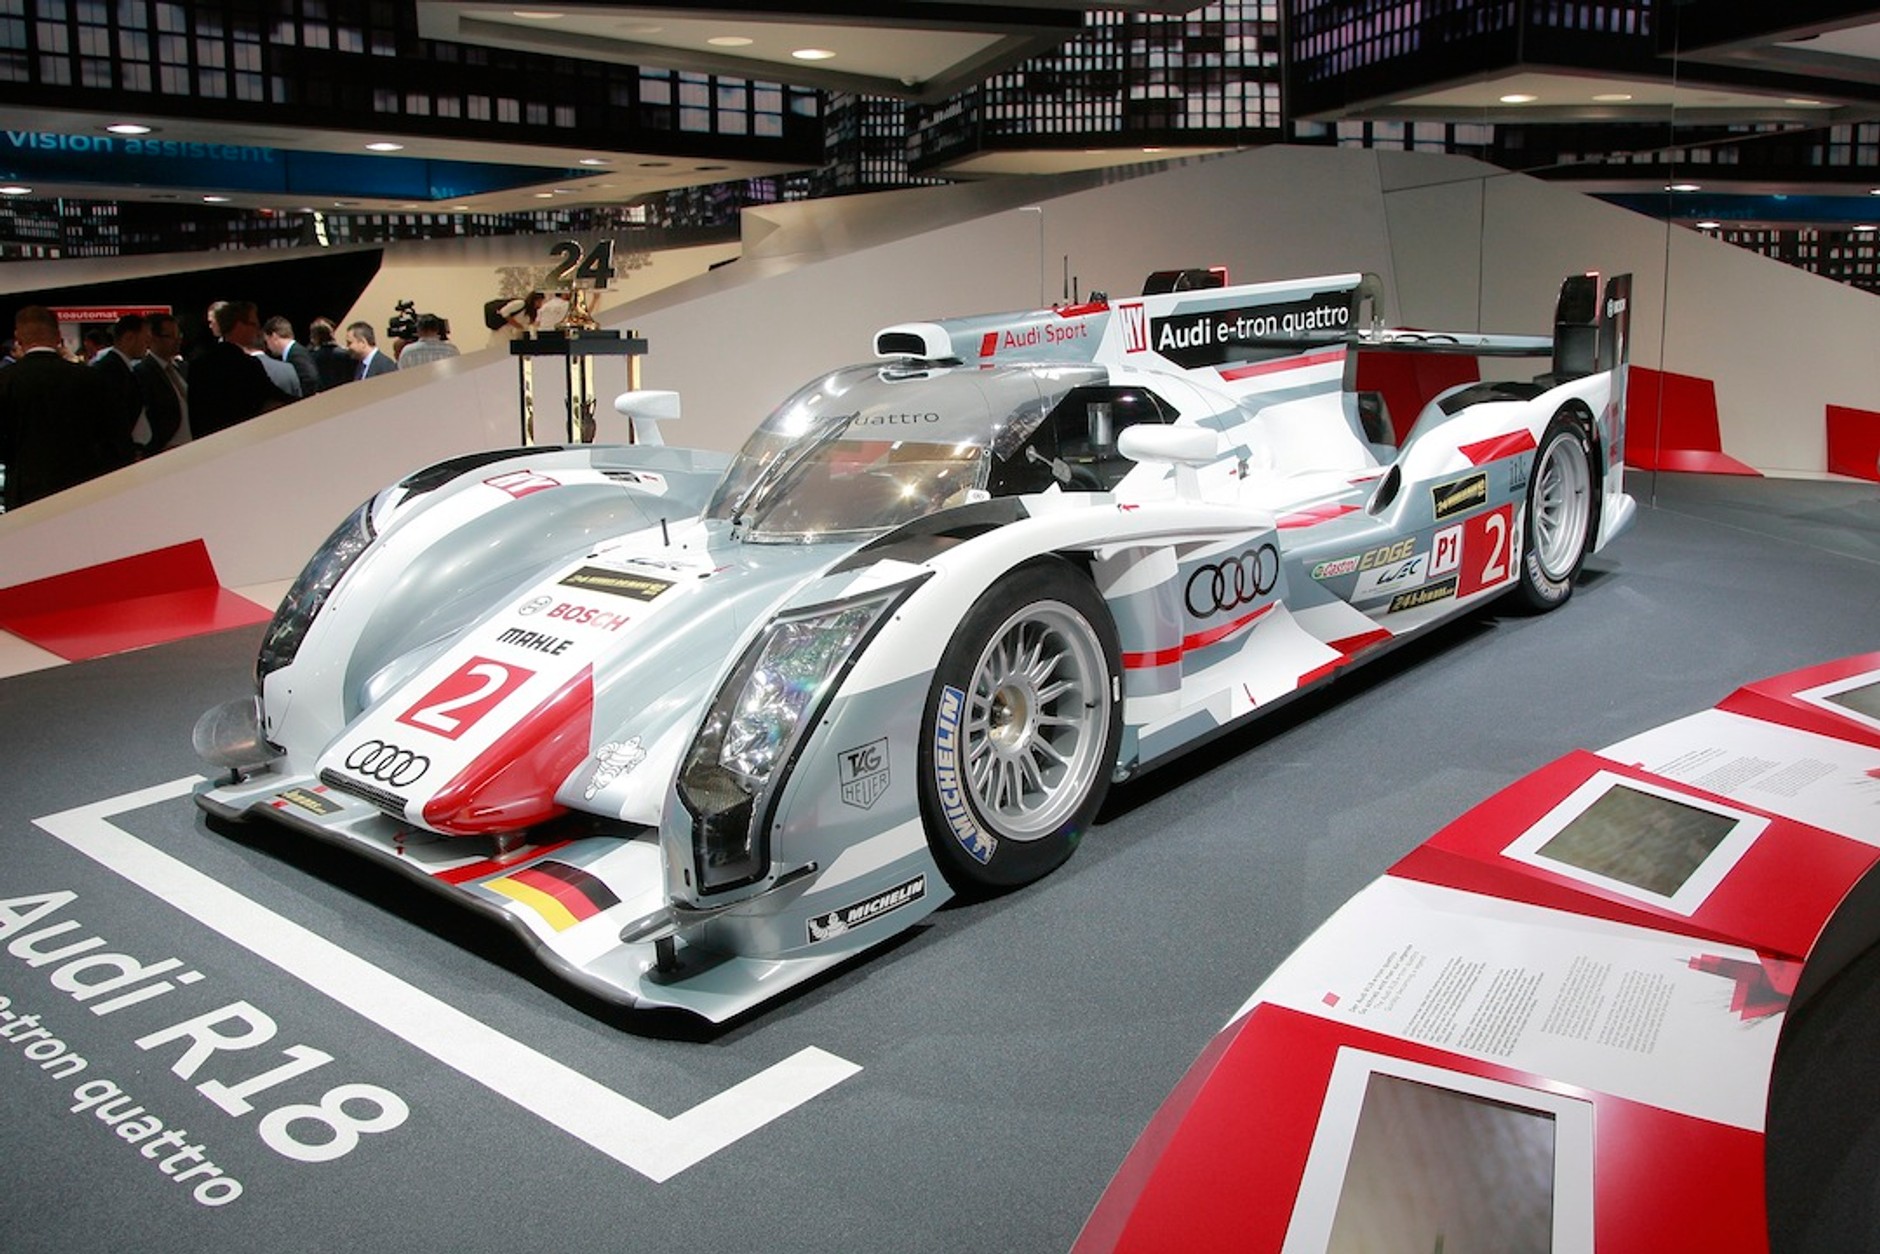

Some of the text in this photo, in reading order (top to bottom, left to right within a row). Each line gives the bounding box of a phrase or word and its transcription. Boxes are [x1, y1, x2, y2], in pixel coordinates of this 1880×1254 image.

[544, 239, 616, 289] 24
[1003, 323, 1087, 349] Audi Sport
[1158, 306, 1349, 351] Audi e-tron quattro
[851, 412, 940, 426] uattro
[1358, 537, 1417, 571] EDGE
[1435, 534, 1456, 568] P1
[1481, 513, 1506, 585] 2
[547, 602, 631, 632] BOSCH
[496, 627, 574, 656] MAHLE
[410, 662, 509, 733] 2
[847, 746, 882, 777] TAG
[937, 690, 977, 841] MICHELIN
[846, 774, 888, 807] HEUER
[846, 883, 924, 923] MICHELIN
[0, 890, 410, 1162] Audi R18
[70, 1079, 243, 1206] quattro
